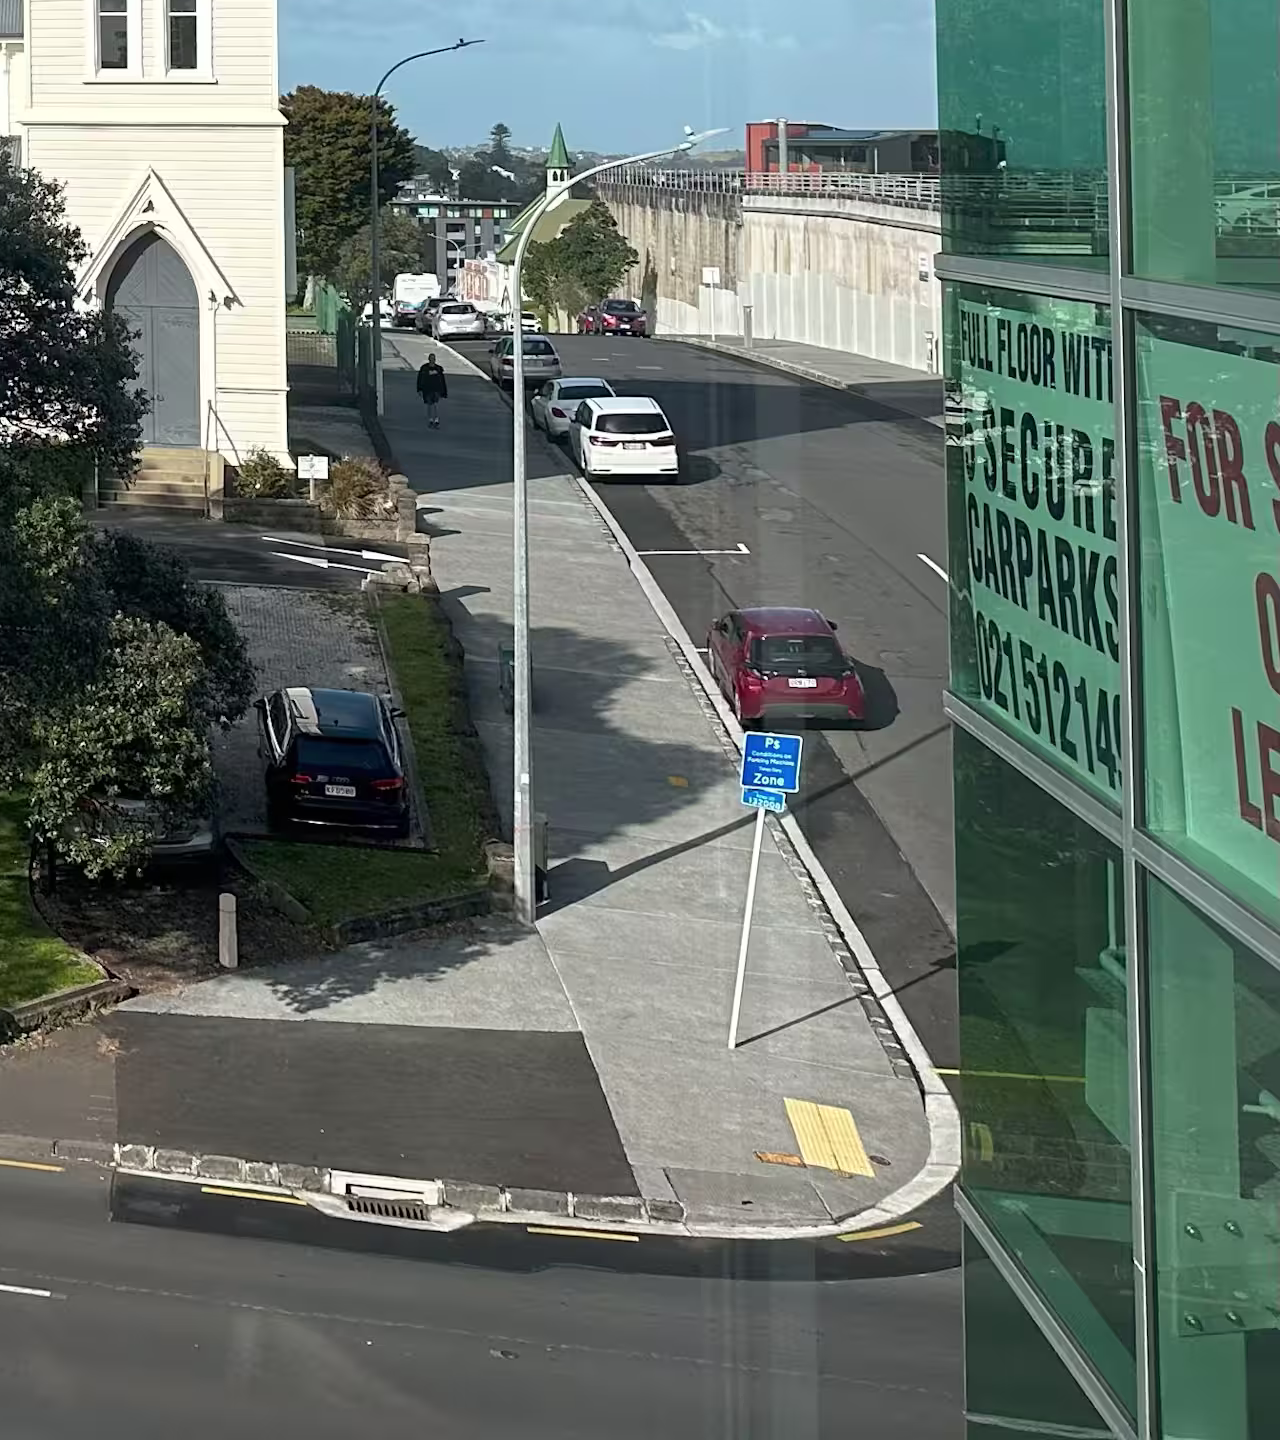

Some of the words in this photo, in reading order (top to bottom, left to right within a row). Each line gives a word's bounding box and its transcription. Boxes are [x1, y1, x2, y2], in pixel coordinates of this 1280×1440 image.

[961, 309, 993, 373] FULL
[997, 318, 1056, 390] FLOOR
[982, 400, 1117, 542] SECURE
[1159, 394, 1256, 532] FOR
[968, 492, 1120, 664] CARPARKS
[753, 773, 784, 786] Zone
